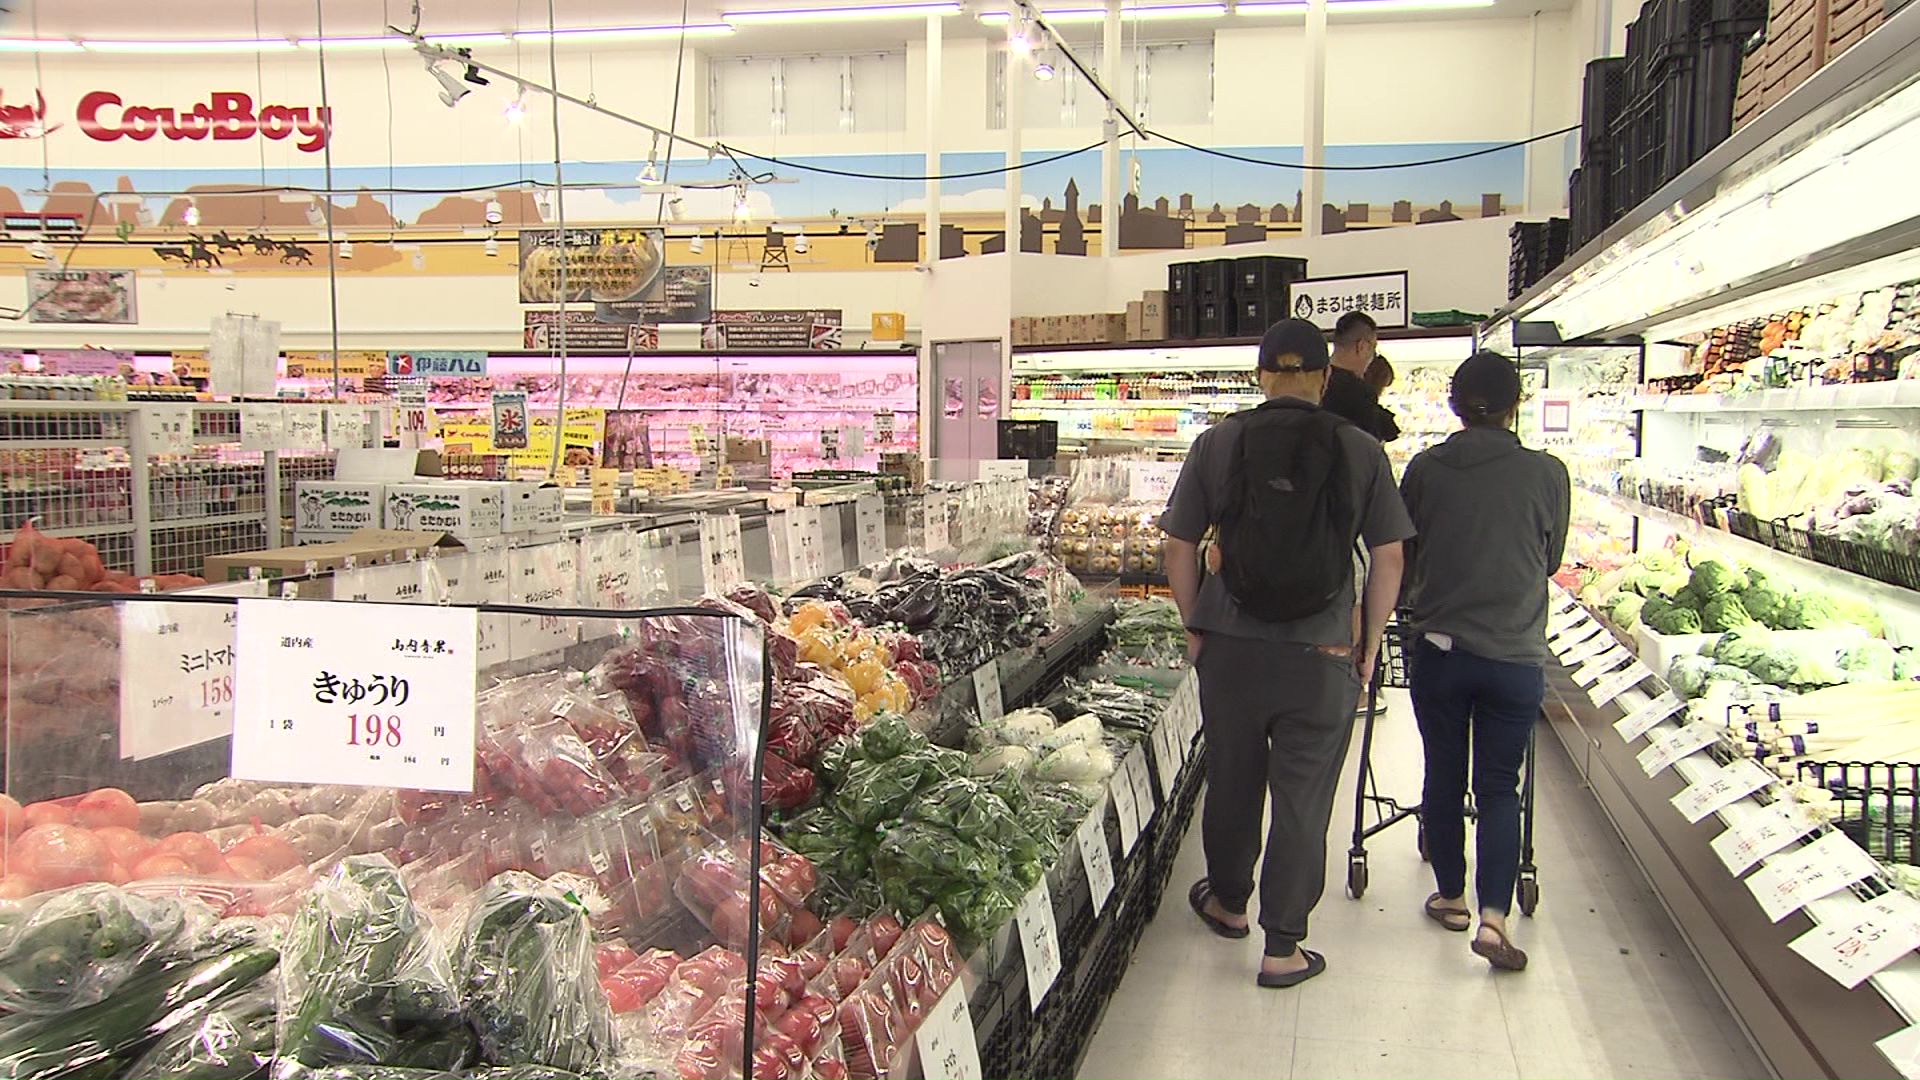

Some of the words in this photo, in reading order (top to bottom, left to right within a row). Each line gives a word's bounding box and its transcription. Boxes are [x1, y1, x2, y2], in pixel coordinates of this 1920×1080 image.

[76, 91, 331, 152] CowBoy
[1316, 291, 1402, 314] まるは製麺所
[415, 357, 481, 372] 伊藤ハム
[407, 410, 425, 432] 109
[500, 408, 521, 431] 氷
[330, 511, 371, 523] きたかむい
[420, 515, 461, 527] きたかむい
[280, 636, 314, 649] 道内産
[180, 644, 236, 674] ミニトマト
[201, 675, 233, 708] 158
[312, 671, 409, 707] きゅうり
[346, 713, 402, 748] 198
[433, 726, 445, 737] 円
